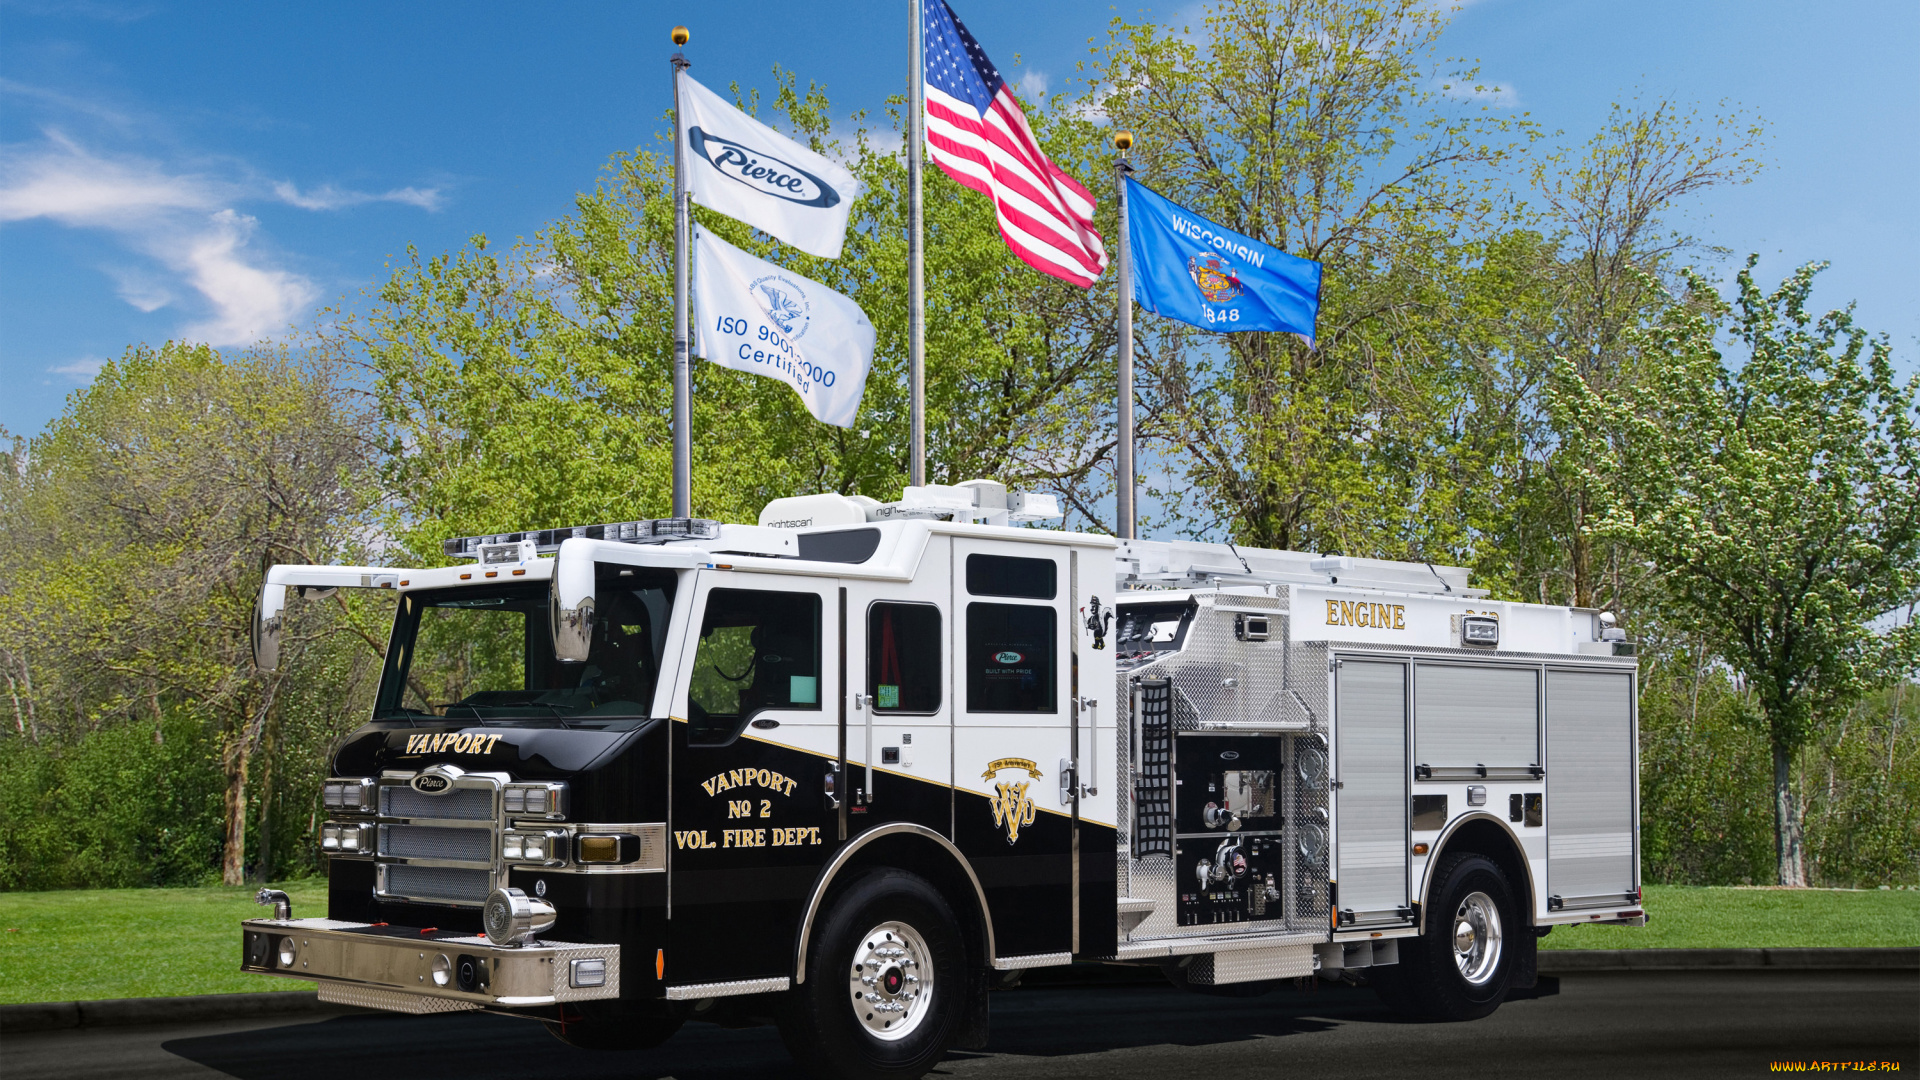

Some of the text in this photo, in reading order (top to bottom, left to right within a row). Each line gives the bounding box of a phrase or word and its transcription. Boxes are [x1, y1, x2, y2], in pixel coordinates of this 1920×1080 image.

[714, 146, 804, 194] Pierce
[1172, 214, 1265, 269] WISCONSIN
[757, 275, 777, 284] Quality
[1201, 303, 1240, 324] 1848
[717, 315, 748, 336] ISO
[738, 343, 810, 395] Certified
[1325, 599, 1405, 630] ENGINE
[405, 733, 503, 754] VANPORT
[419, 776, 444, 788] Pierce
[701, 768, 797, 797] VANPORT
[760, 800, 772, 818] 2
[674, 827, 822, 850] VOL. FIRE DEPT.
